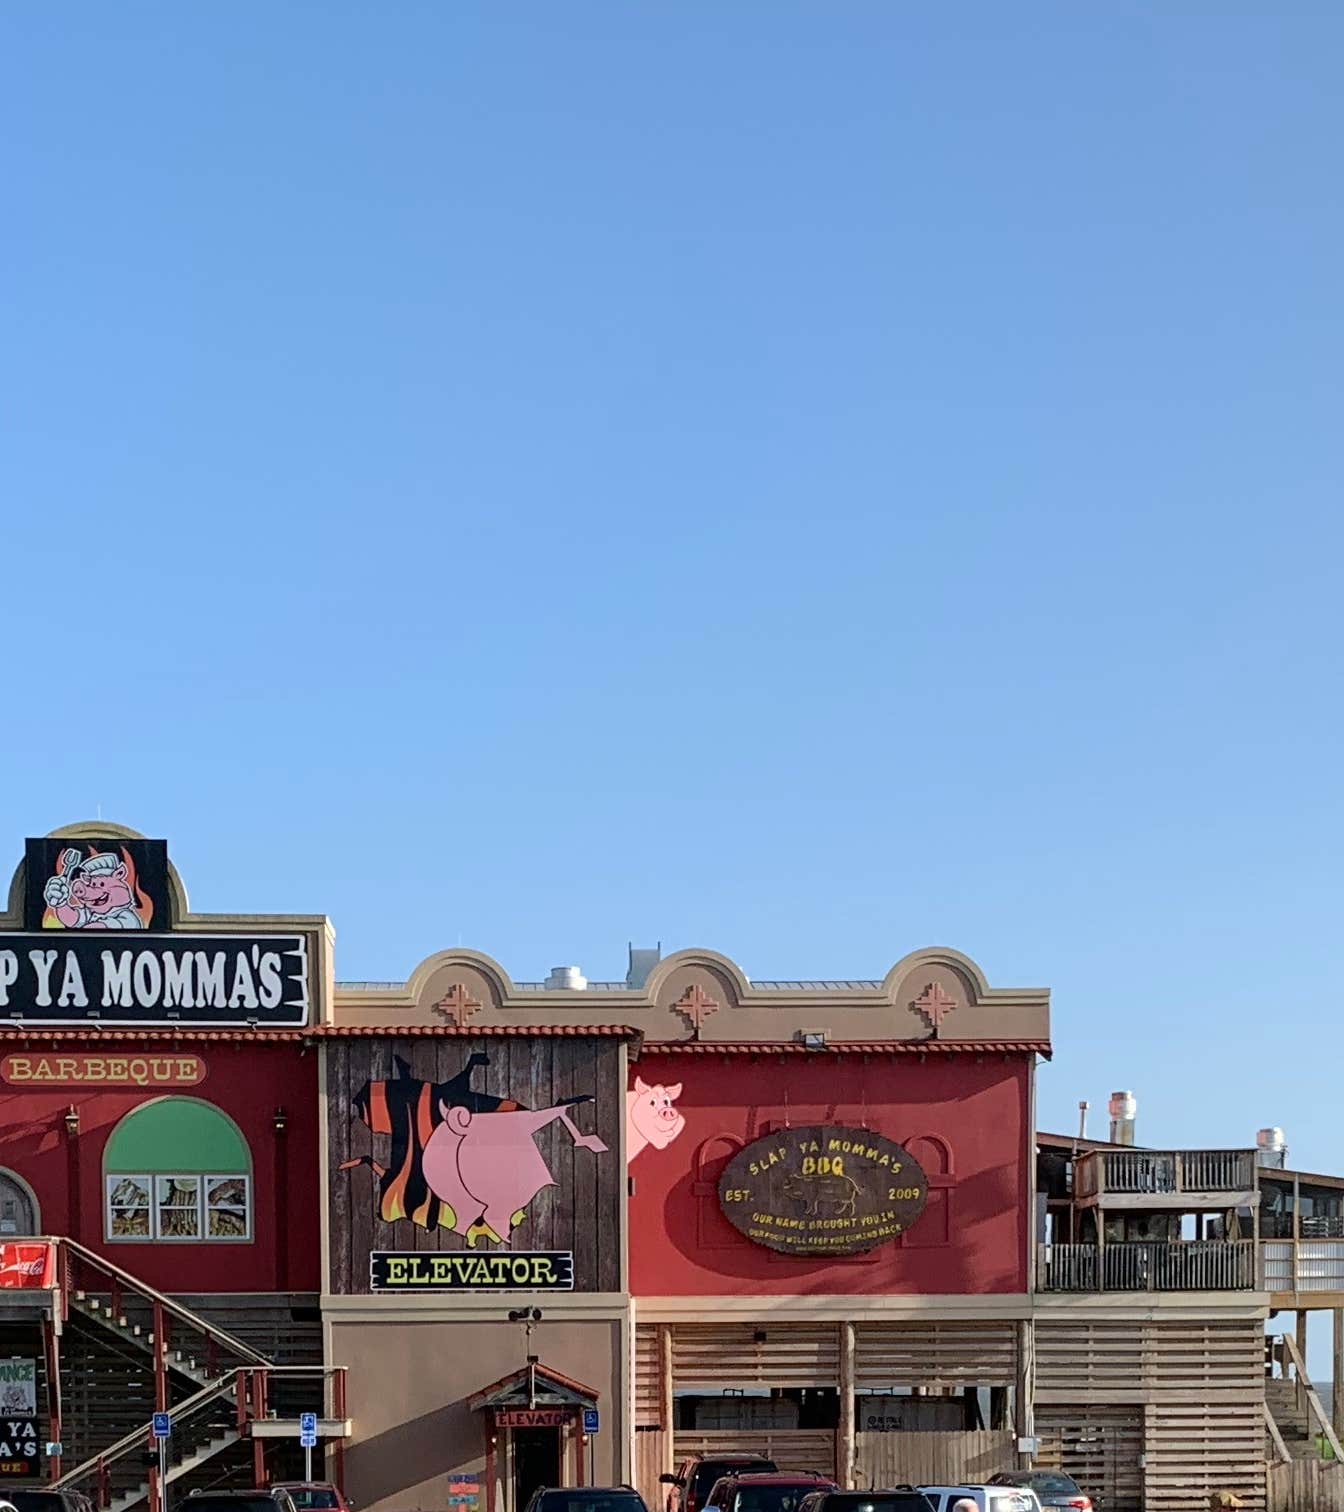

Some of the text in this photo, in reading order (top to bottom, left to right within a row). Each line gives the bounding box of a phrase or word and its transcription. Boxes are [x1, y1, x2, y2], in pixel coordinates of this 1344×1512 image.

[29, 949, 88, 1007] YA
[101, 943, 283, 1009] MOMMA'S
[9, 1058, 198, 1086] BARBEQUE
[749, 1139, 902, 1176] SLAP YA MOMMA'S
[802, 1156, 843, 1176] BBQ
[725, 1188, 920, 1201] EST. 2009
[386, 1257, 557, 1284] ELEVATOR
[7, 1422, 36, 1437] YA
[499, 1412, 571, 1425] ELEVATOR
